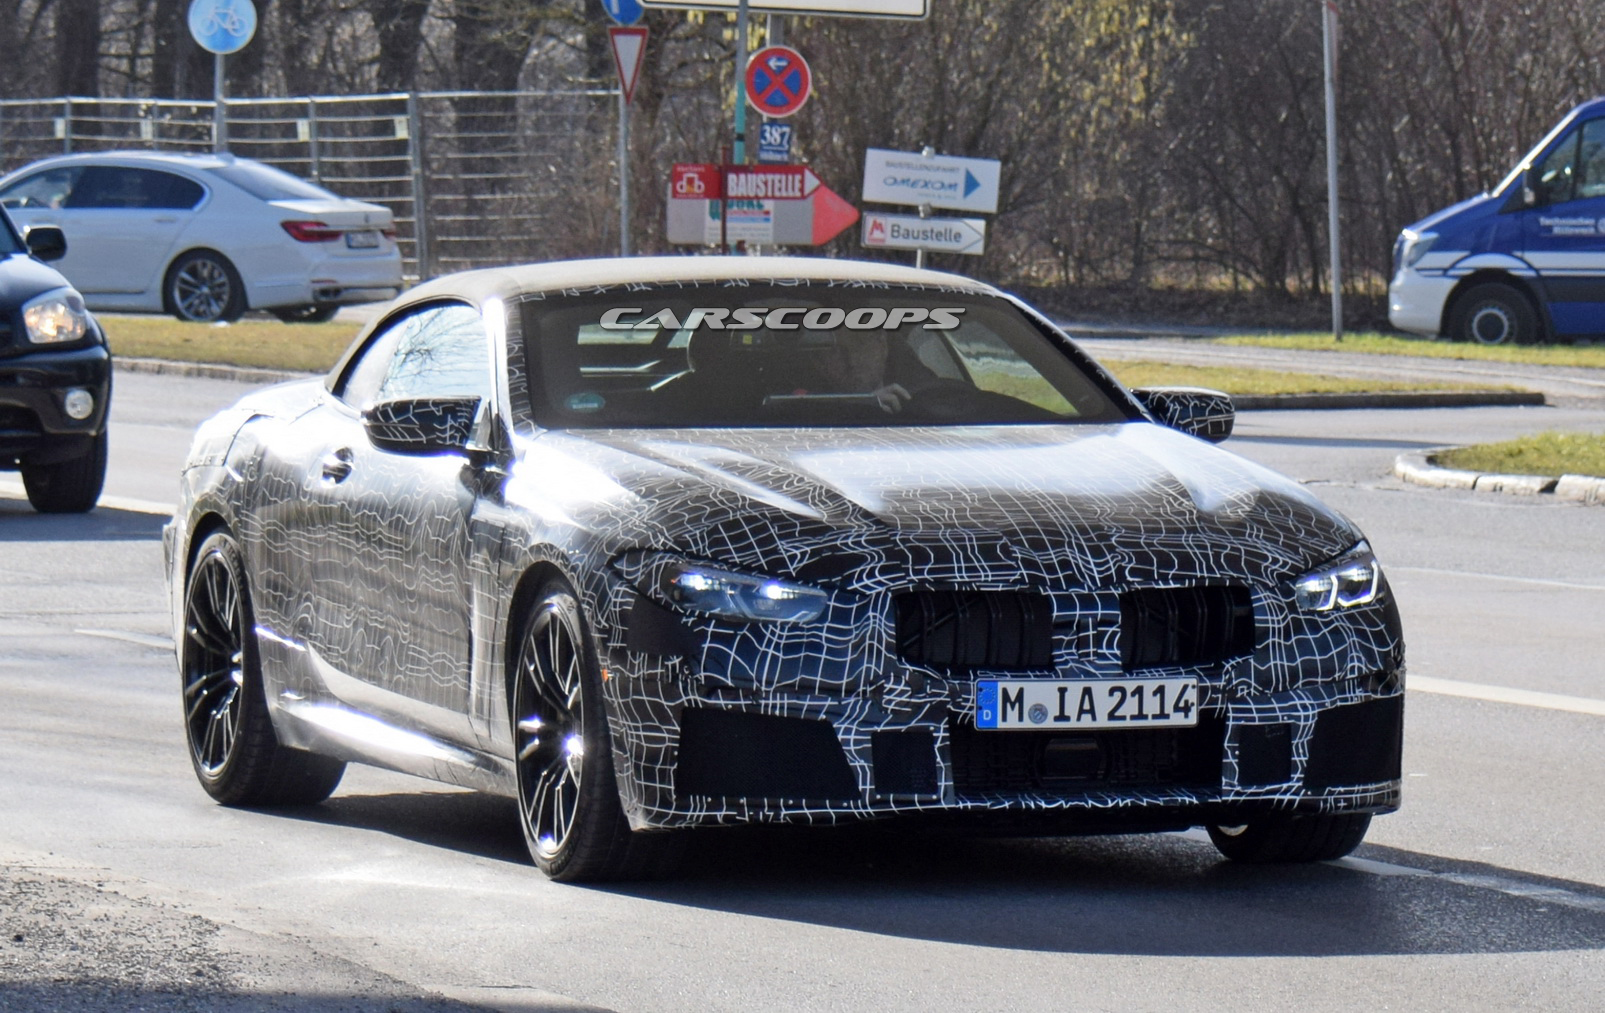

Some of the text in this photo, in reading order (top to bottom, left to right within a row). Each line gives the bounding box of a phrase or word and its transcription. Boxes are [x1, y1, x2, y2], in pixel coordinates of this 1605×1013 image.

[760, 124, 791, 150] 387
[727, 173, 803, 198] BAUSTELLE
[890, 222, 963, 243] Baustelle
[982, 709, 992, 721] D
[1001, 684, 1193, 723] M IA 2114
